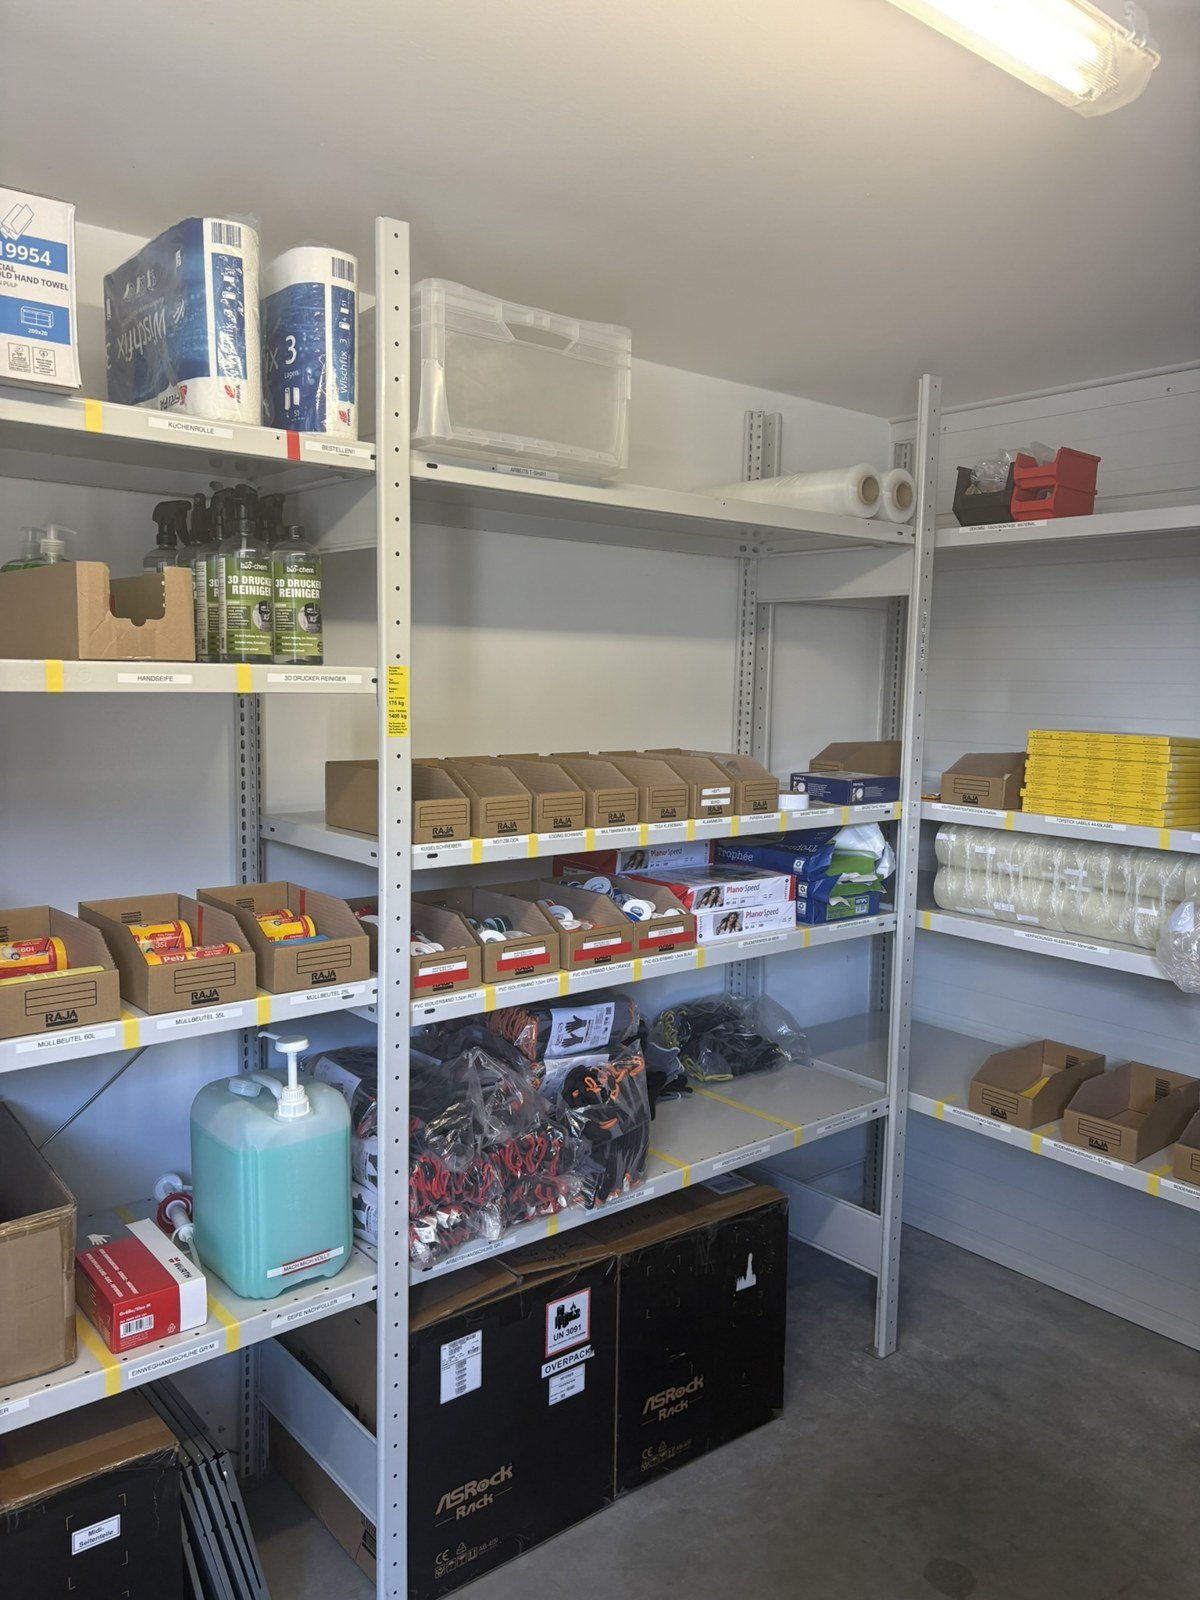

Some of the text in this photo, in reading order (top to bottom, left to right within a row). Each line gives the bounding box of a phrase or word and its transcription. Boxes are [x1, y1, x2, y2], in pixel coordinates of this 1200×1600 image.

[3, 281, 19, 289] PULP
[14, 274, 40, 285] HAND
[41, 278, 70, 292] TOWEL
[284, 334, 298, 366] 3
[284, 369, 300, 380] Lagen
[227, 575, 239, 585] 3D
[275, 579, 285, 588] 3D
[279, 588, 320, 599] REINIGER
[137, 674, 174, 683] HANDSEIFE
[284, 674, 346, 683] 3D DRUCKER REINIGER
[962, 794, 979, 802] RAJA
[753, 800, 768, 809] RAJA
[608, 813, 626, 821] RAJA
[660, 808, 676, 816] RAJA
[497, 821, 518, 830] RAJA
[553, 817, 572, 825] RAJA
[432, 826, 454, 835] RAJA
[420, 843, 462, 852] KUGELSCHREIBER
[718, 846, 754, 862] Trophée
[744, 883, 761, 895] Speed
[763, 907, 780, 919] Speed
[163, 954, 185, 963] Pely
[615, 962, 632, 970] ORANGE
[312, 969, 337, 980] RAJA
[191, 988, 219, 1000] RAJA
[306, 990, 340, 1001] MÜLLBEUTEL
[424, 996, 455, 1007] ISOLIERBAND
[45, 1009, 78, 1023] RAJA
[175, 1014, 214, 1026] MÜLLBEUTEL
[37, 1032, 96, 1048] MÜLLBEUTEL 60L
[990, 1106, 1007, 1119] RAJA
[1088, 1137, 1108, 1150] RAJA
[283, 1262, 299, 1273] MACH
[299, 1257, 313, 1267] MICH
[287, 1299, 338, 1321] SEIFE NACHFÜLLER
[553, 1324, 582, 1342] UN 3091
[131, 1349, 198, 1377] EINWEGHANDSCHUHE
[88, 1526, 105, 1537] Midi-
[79, 1530, 114, 1548] Seitenteile
